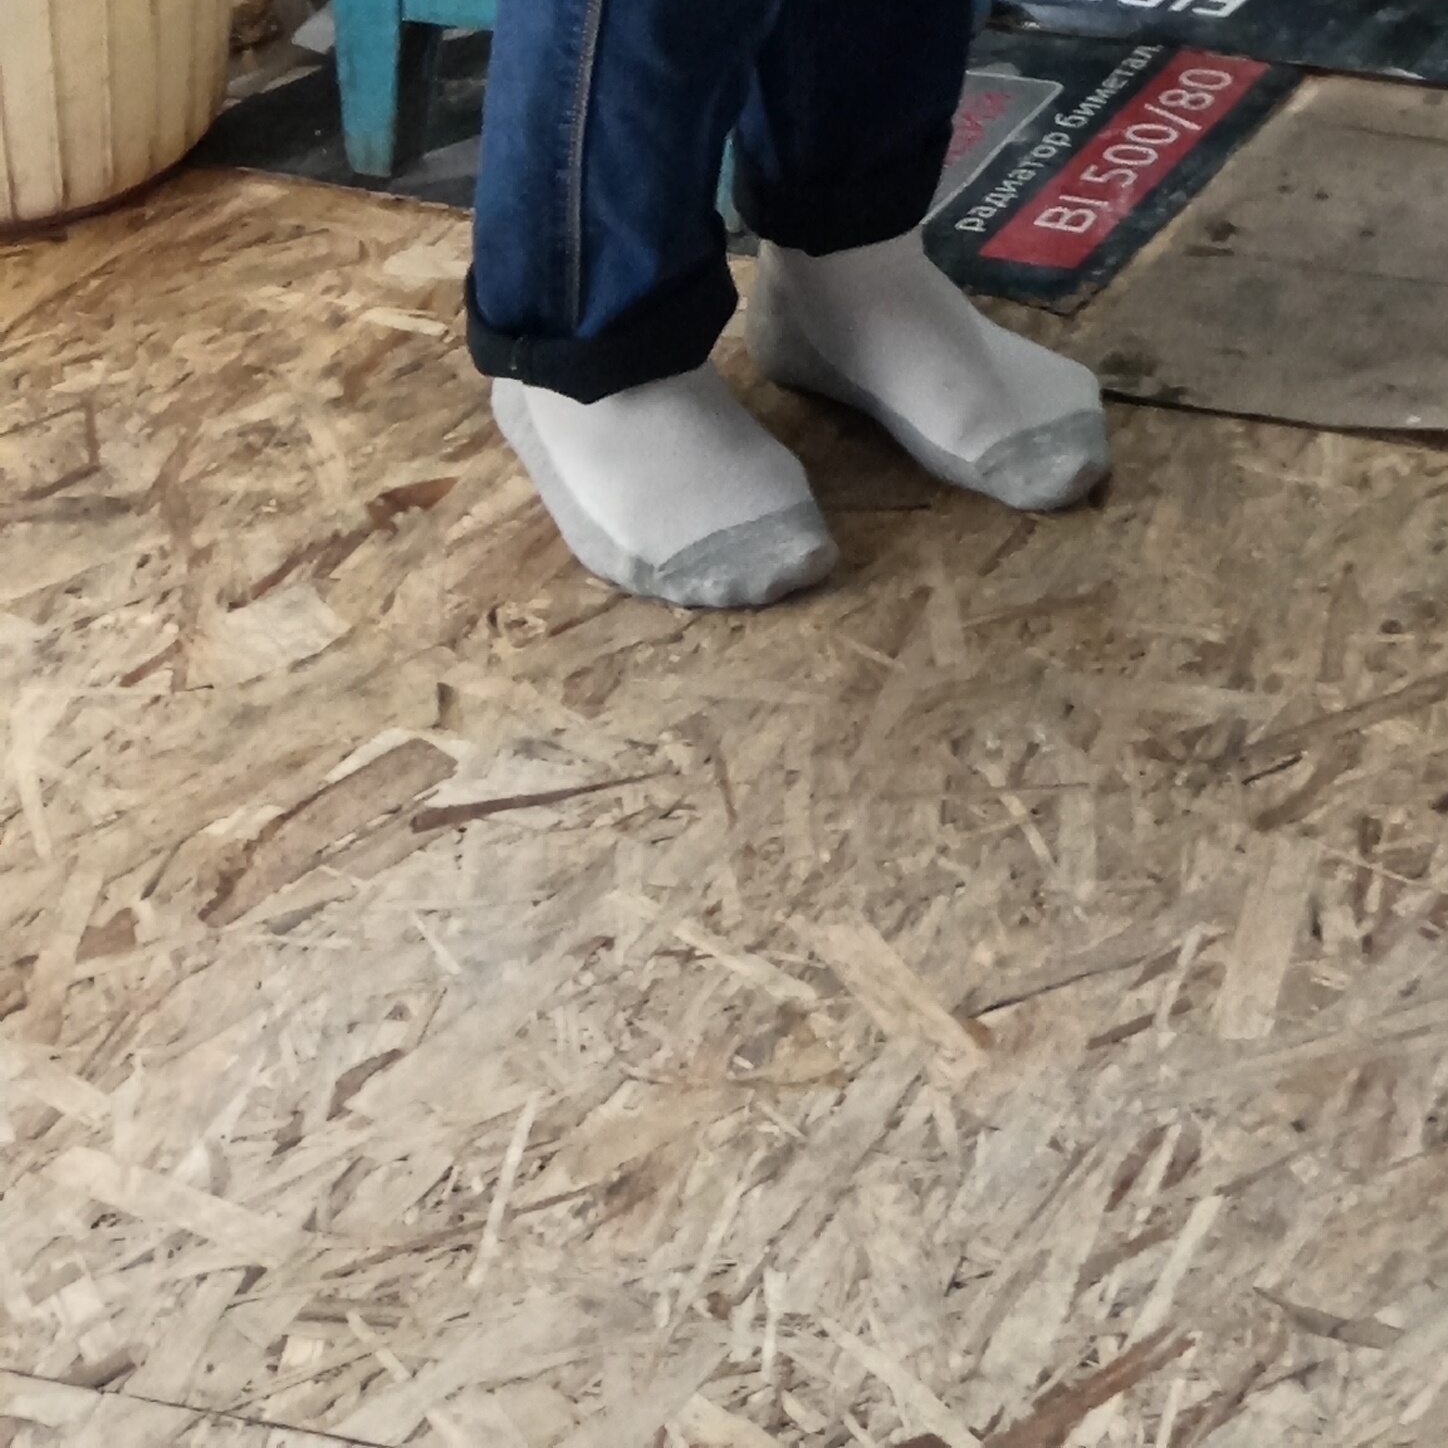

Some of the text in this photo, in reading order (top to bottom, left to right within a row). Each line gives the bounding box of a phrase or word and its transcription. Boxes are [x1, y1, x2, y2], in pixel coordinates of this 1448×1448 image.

[954, 130, 1073, 233] радиатор
[1033, 67, 1233, 234] BI 500/80
